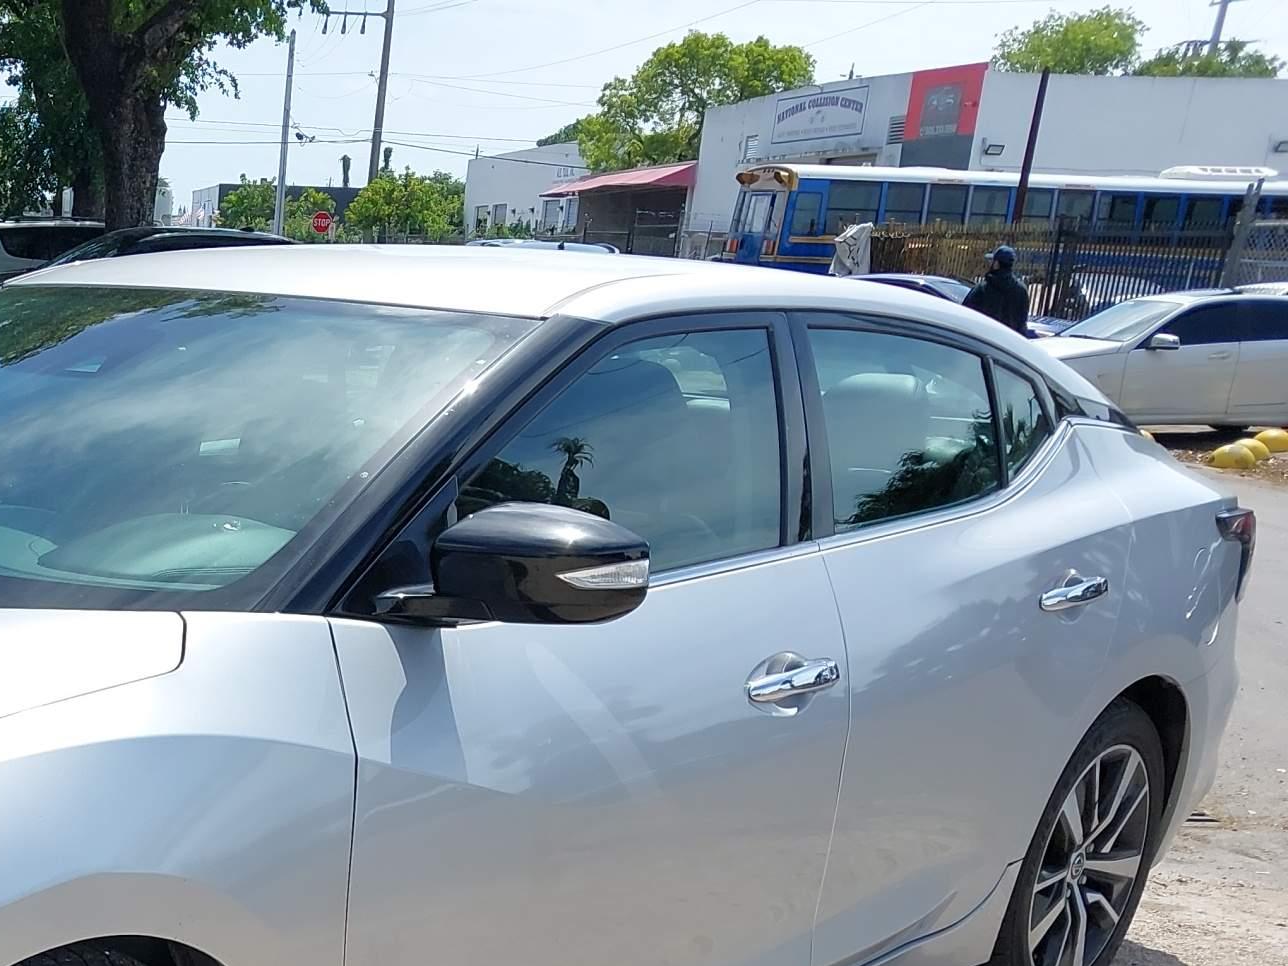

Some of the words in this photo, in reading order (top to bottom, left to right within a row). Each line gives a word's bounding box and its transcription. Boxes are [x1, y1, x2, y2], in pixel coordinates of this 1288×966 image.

[777, 101, 806, 124] NATIONAL
[808, 96, 840, 109] COLLISION
[840, 97, 864, 113] CENTER
[313, 218, 331, 227] STOP
